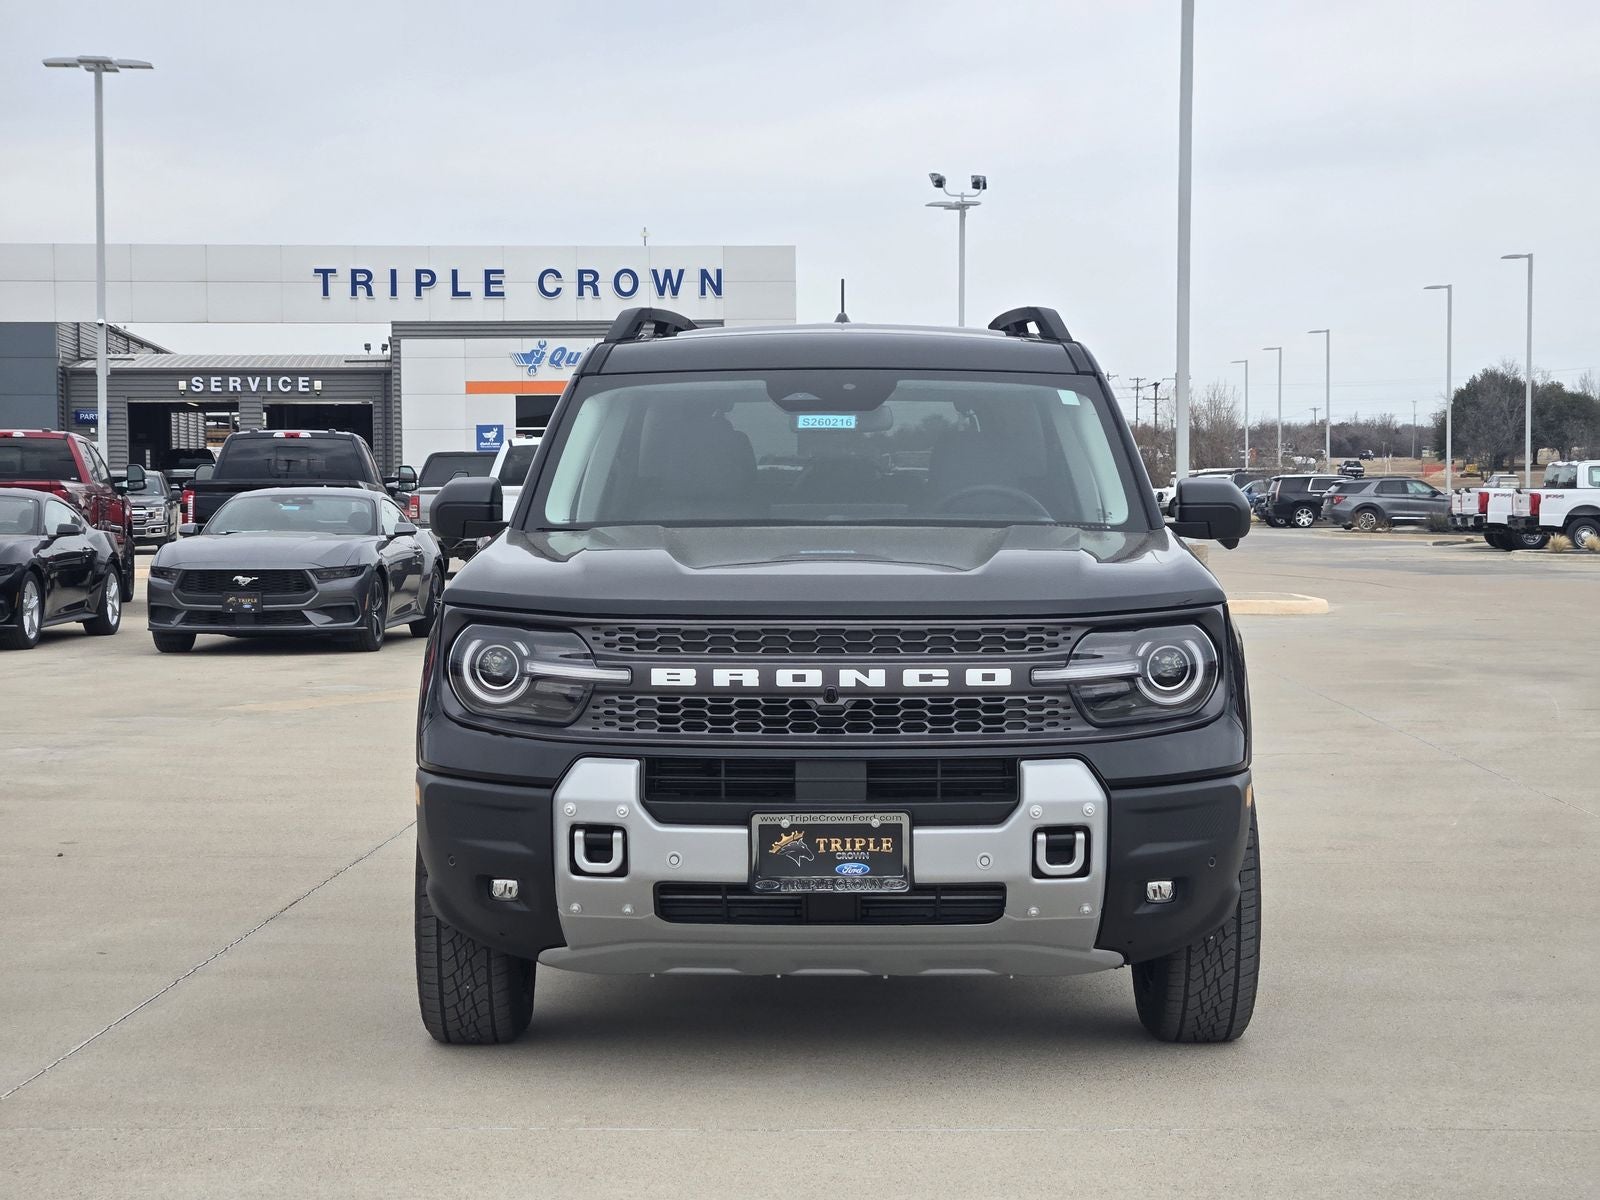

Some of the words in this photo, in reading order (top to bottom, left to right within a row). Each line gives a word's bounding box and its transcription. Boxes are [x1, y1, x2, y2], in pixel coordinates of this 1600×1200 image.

[313, 268, 506, 300] TRIPLE
[536, 268, 724, 300] CROWN
[548, 346, 583, 369] Qu
[190, 376, 310, 392] SERVICE
[802, 418, 852, 427] S260216
[650, 668, 1012, 688] BRONCO
[760, 814, 902, 823] wwwTripleCrownFordcom
[816, 837, 893, 853] TRIPLE
[835, 851, 870, 860] CROWN
[841, 864, 864, 874] Ford
